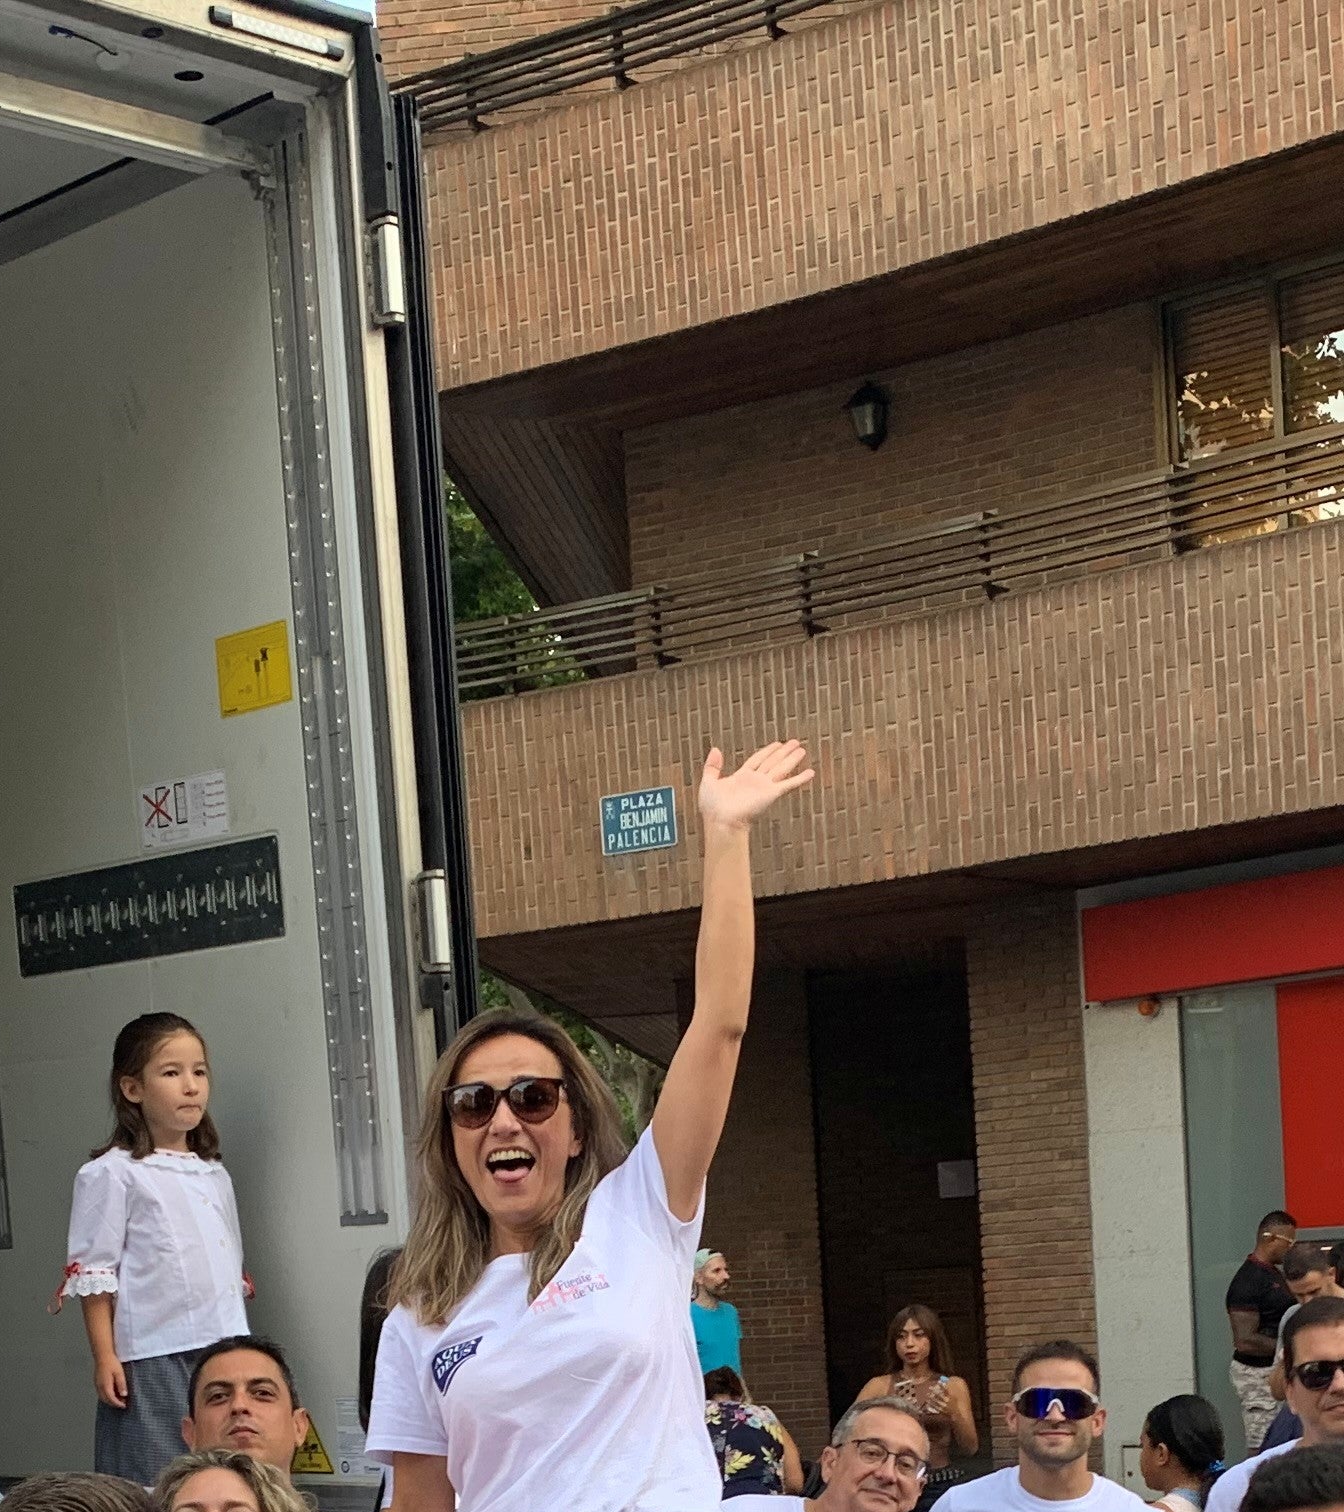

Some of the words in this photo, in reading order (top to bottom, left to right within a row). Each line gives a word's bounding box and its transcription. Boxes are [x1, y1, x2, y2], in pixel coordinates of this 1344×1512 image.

[620, 792, 663, 810] PLAZA
[619, 806, 668, 830] BENJAMIN
[607, 825, 671, 850] PALENCIA
